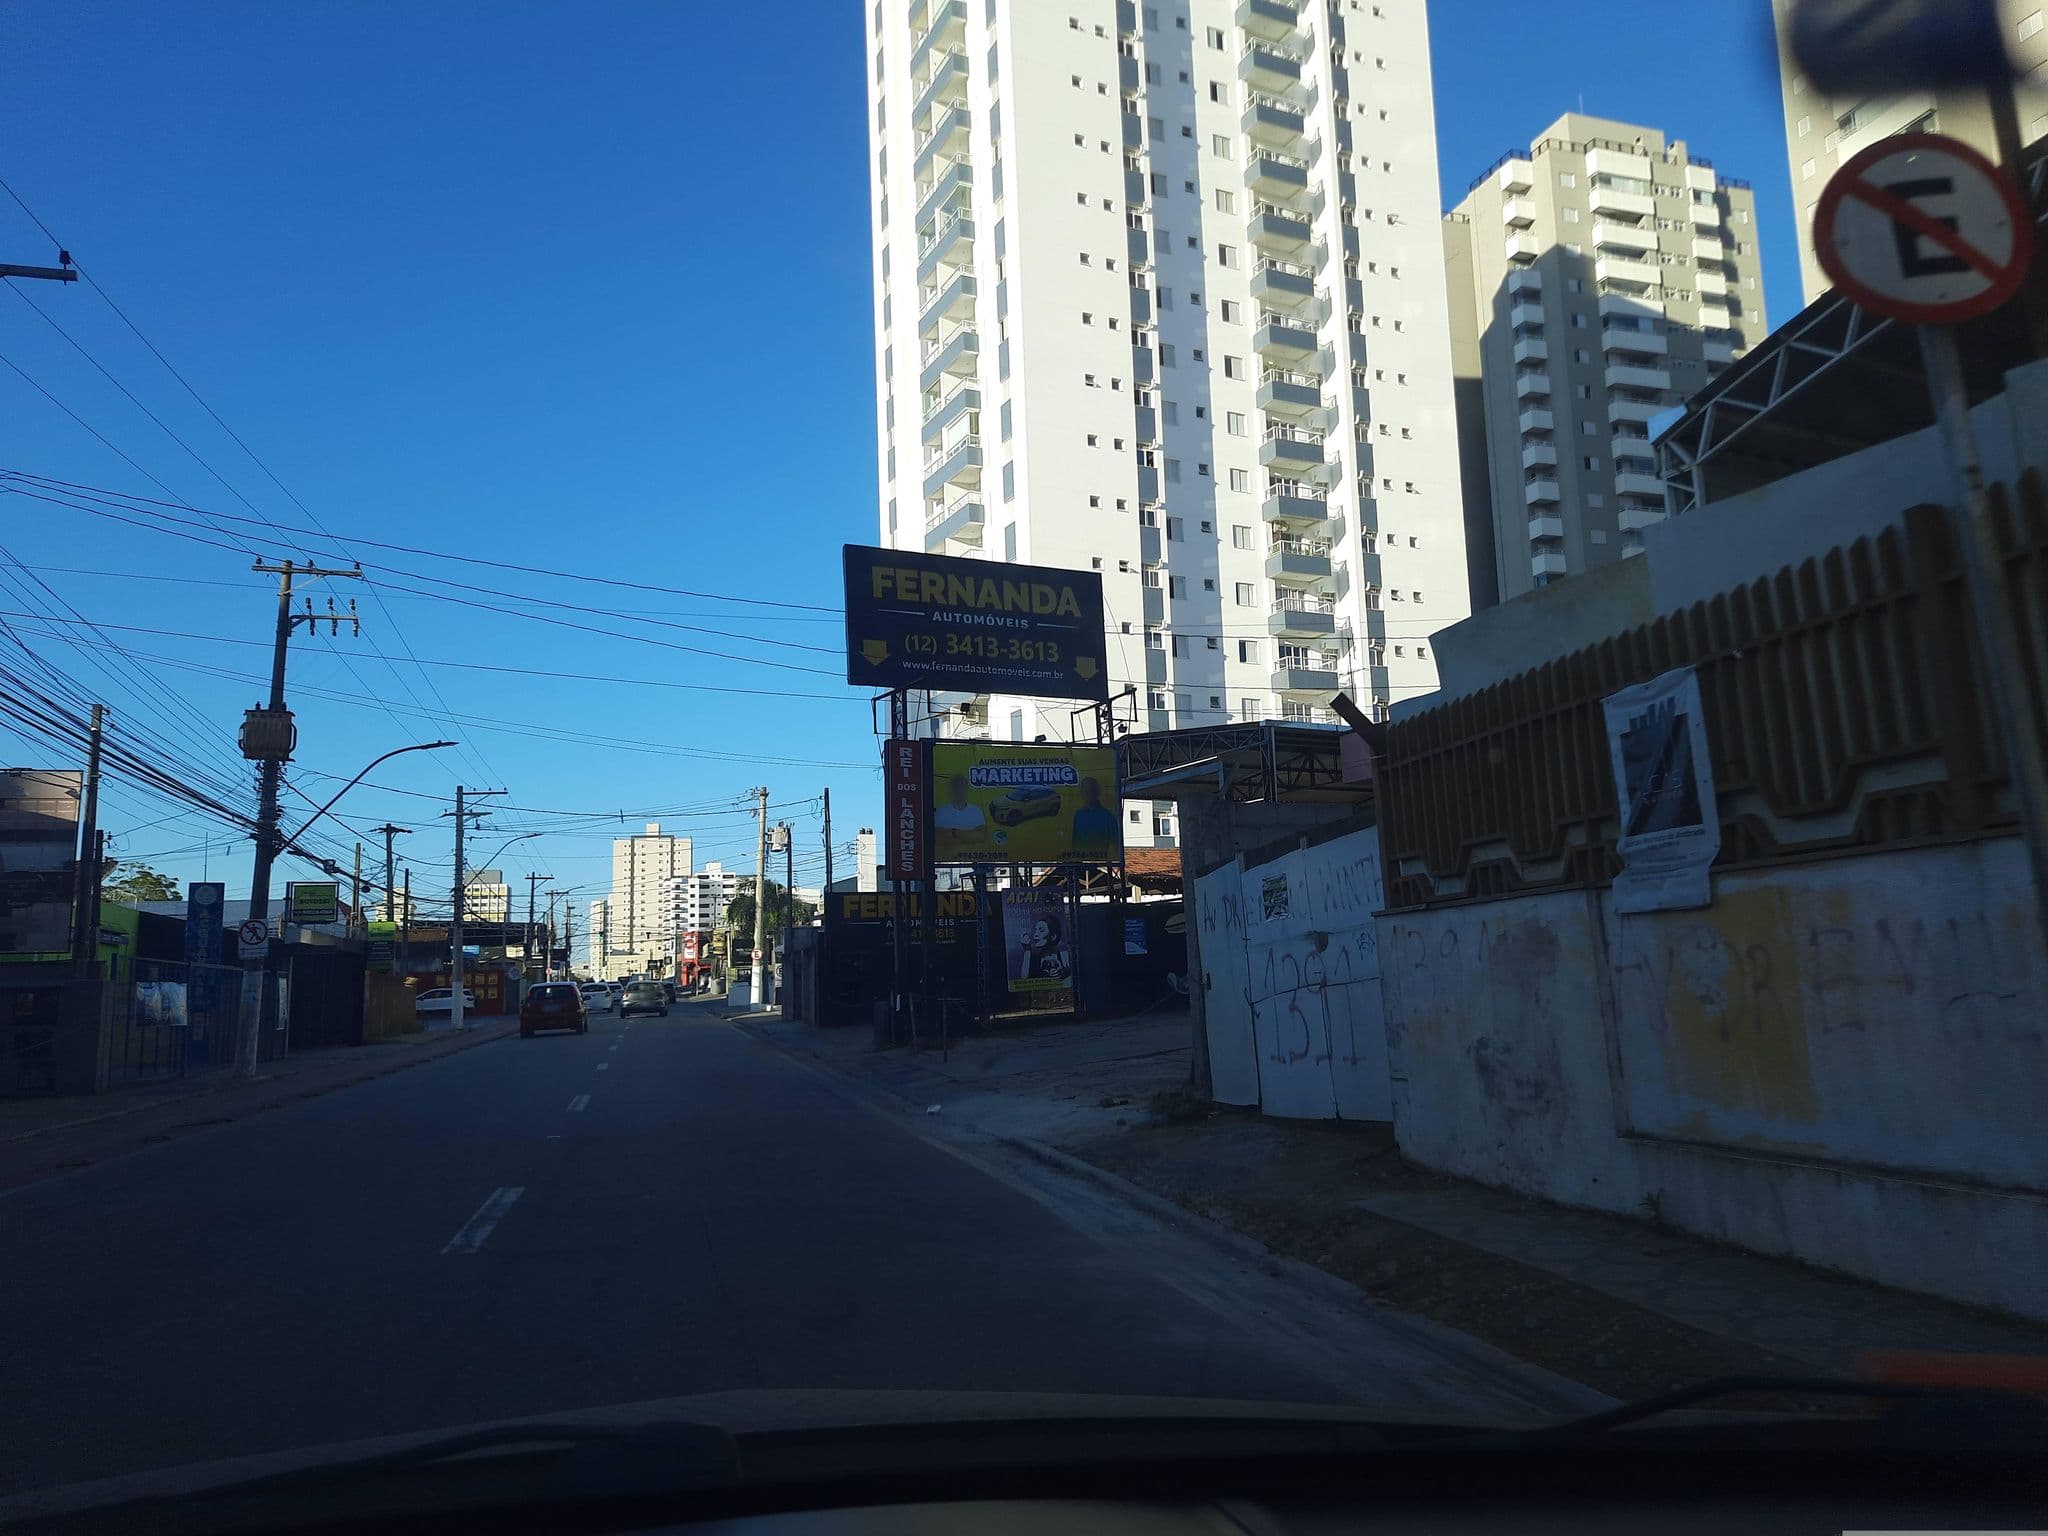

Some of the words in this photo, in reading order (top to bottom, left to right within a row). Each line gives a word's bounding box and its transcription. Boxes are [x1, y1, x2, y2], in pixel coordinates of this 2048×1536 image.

[1883, 177, 1972, 280] E
[871, 566, 1081, 617] FERNANDA
[932, 611, 1030, 629] AUTOMÓVEIS
[904, 631, 938, 655] (12)
[945, 633, 1060, 663] 3413-3613
[902, 660, 1064, 680] www.fernandaautomoveis.com.br
[899, 747, 913, 778] REI
[978, 758, 1016, 766] AUMENTE
[1017, 758, 1037, 766] SUAS
[1039, 757, 1070, 765] VENDAS
[897, 783, 917, 791] DOS
[970, 766, 1075, 784] MARKETING
[899, 797, 915, 872] LANCHES
